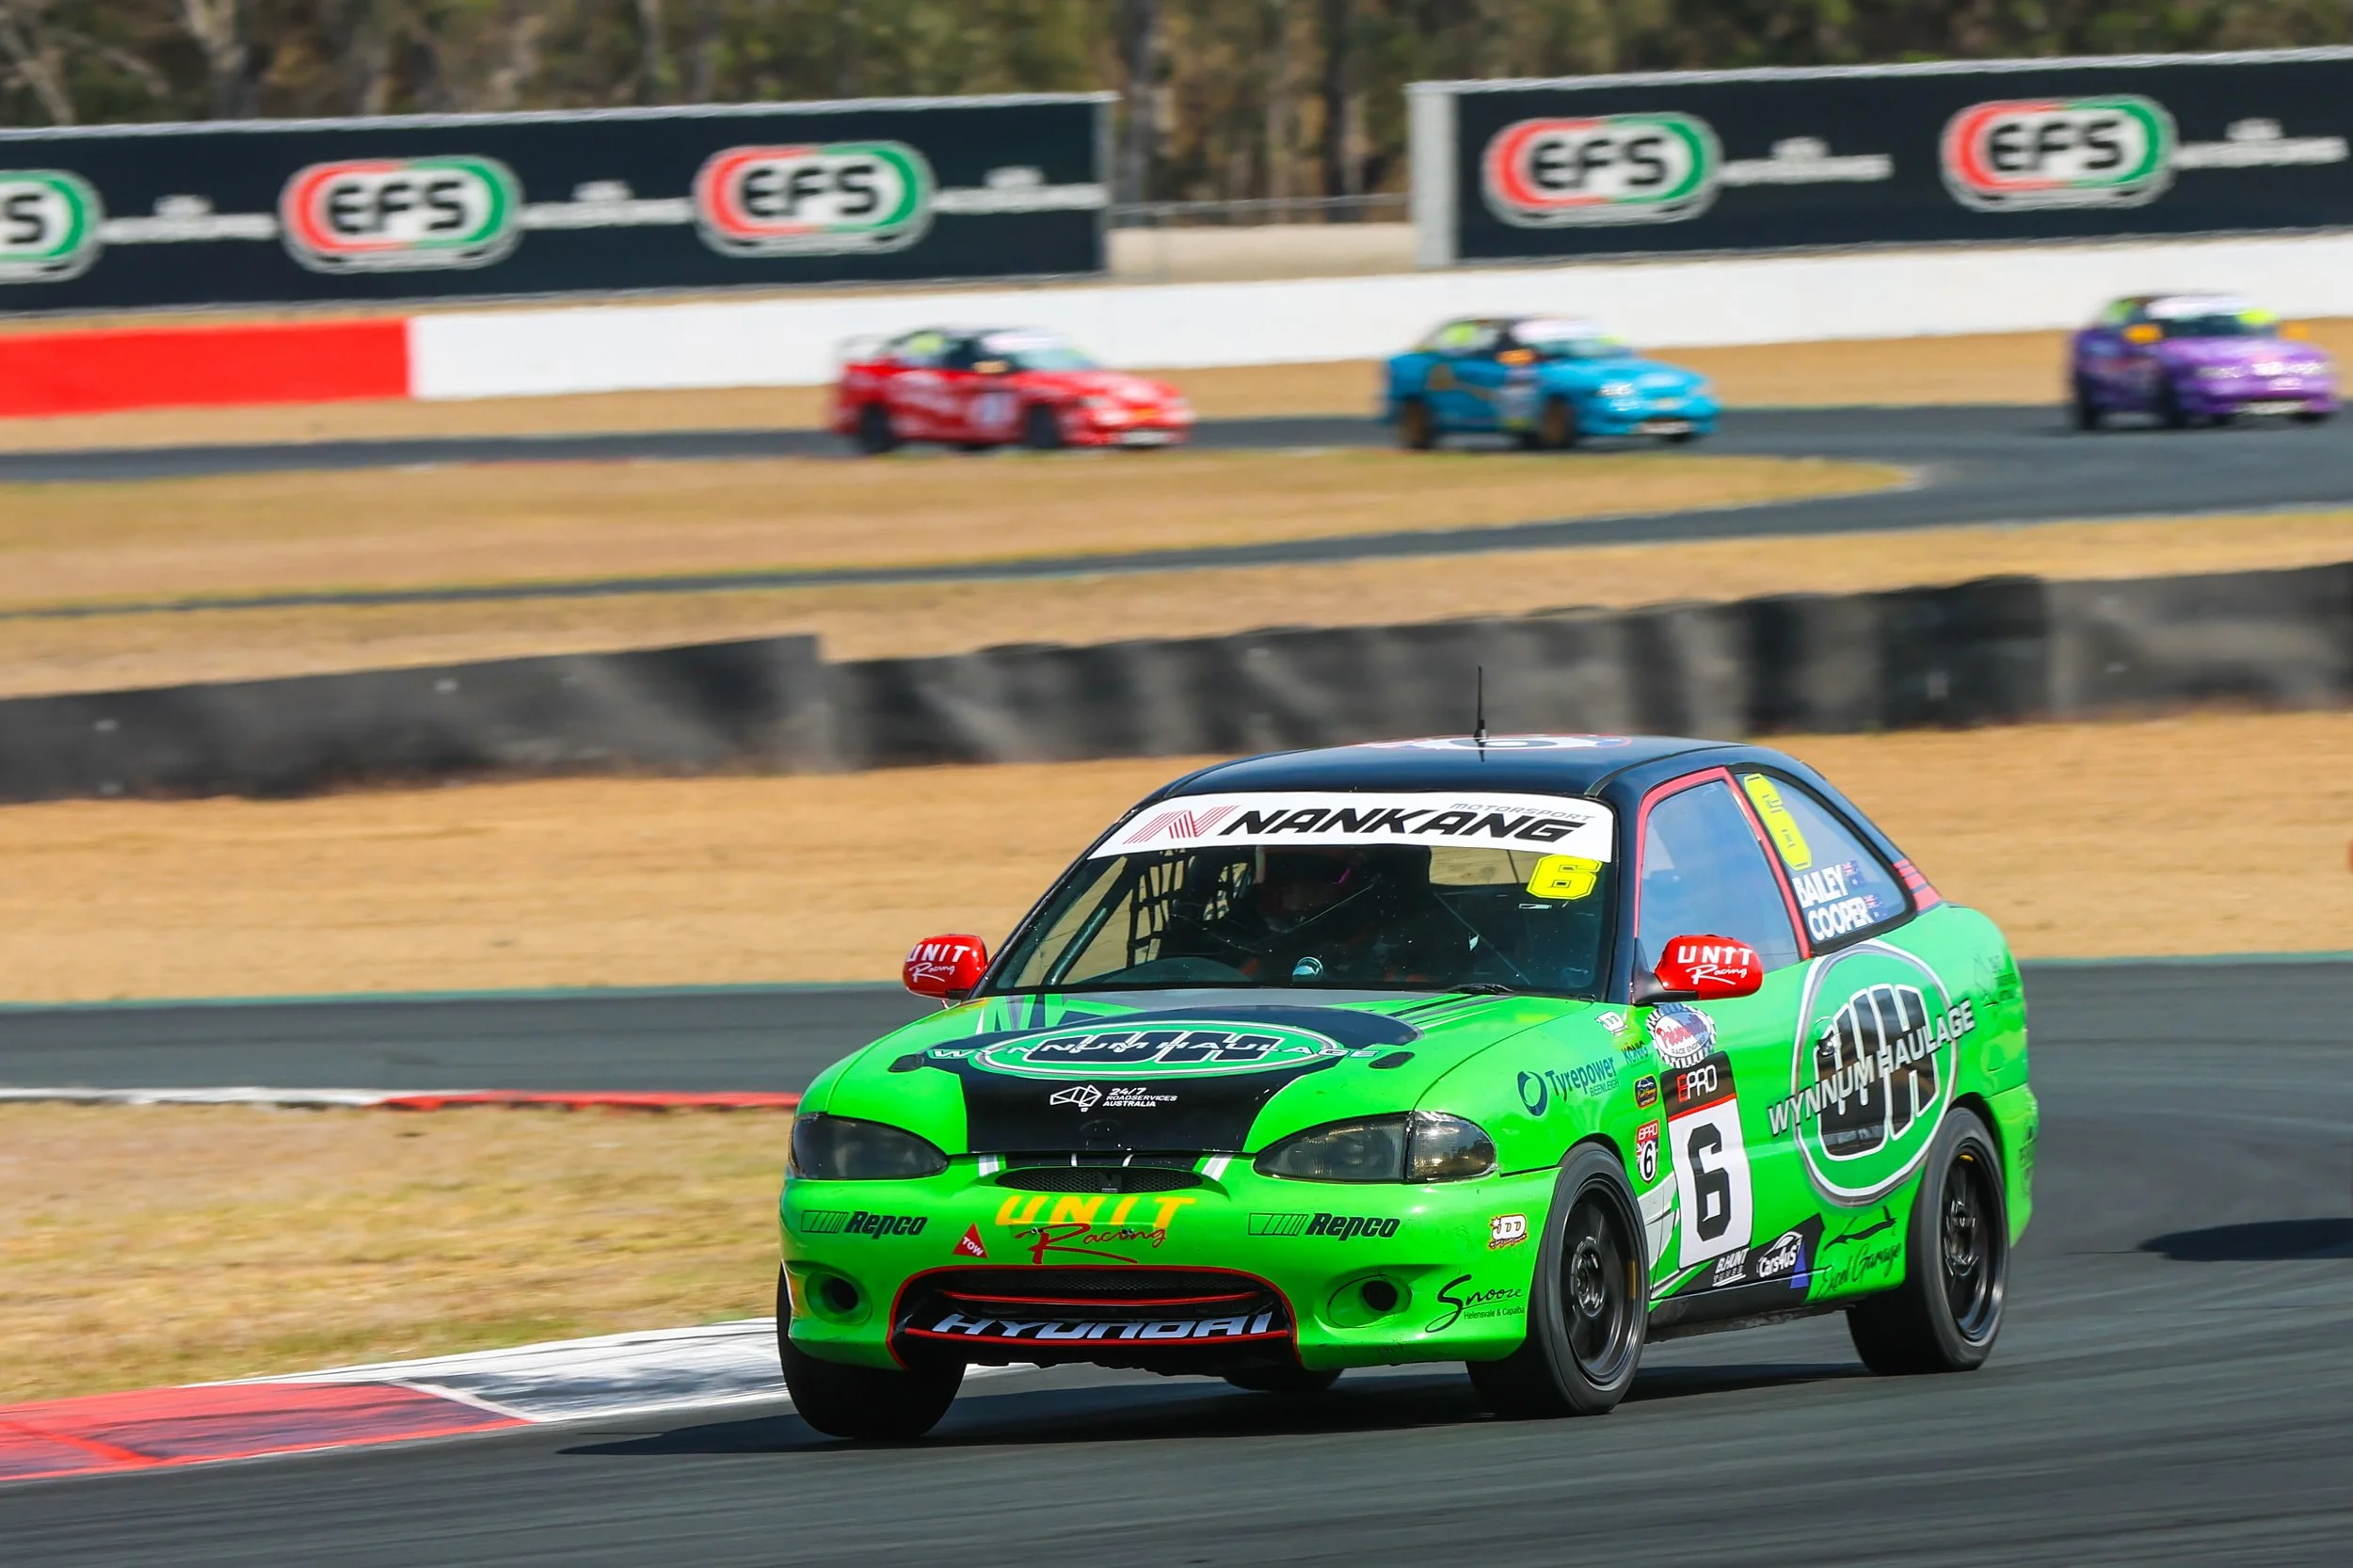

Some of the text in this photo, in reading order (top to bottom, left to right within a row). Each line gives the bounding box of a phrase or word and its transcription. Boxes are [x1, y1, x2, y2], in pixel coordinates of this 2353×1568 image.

[1529, 136, 1667, 189] EFS
[1989, 120, 2123, 171] EFS
[326, 180, 467, 233] EFS
[740, 163, 880, 217] EFS
[1222, 807, 1588, 843] NANKANG
[1449, 802, 1596, 821] MOTORSPORT
[1743, 773, 1813, 872] 6
[1526, 854, 1603, 901] 6
[1791, 864, 1849, 909] BAILEY
[1807, 896, 1875, 941] COOPER
[906, 943, 971, 963] UNIT
[908, 962, 956, 984] Racing
[1685, 964, 1748, 985] Racing
[1155, 1042, 1381, 1058] HAULAGE
[1767, 999, 1977, 1137] WYNNUM HAULAGE
[1110, 1087, 1147, 1096] 24/7
[1545, 1056, 1617, 1102] Tyrepower
[1643, 1142, 1655, 1177] 6
[1688, 1123, 1731, 1242] 6
[847, 1210, 928, 1240] Repco
[996, 1195, 1196, 1228] UNIT
[1306, 1212, 1401, 1241] Repco
[962, 1236, 984, 1256] TOW
[1015, 1223, 1168, 1265] Racing
[1424, 1273, 1524, 1334] Snooze
[932, 1312, 1273, 1339] HYUNDAI
